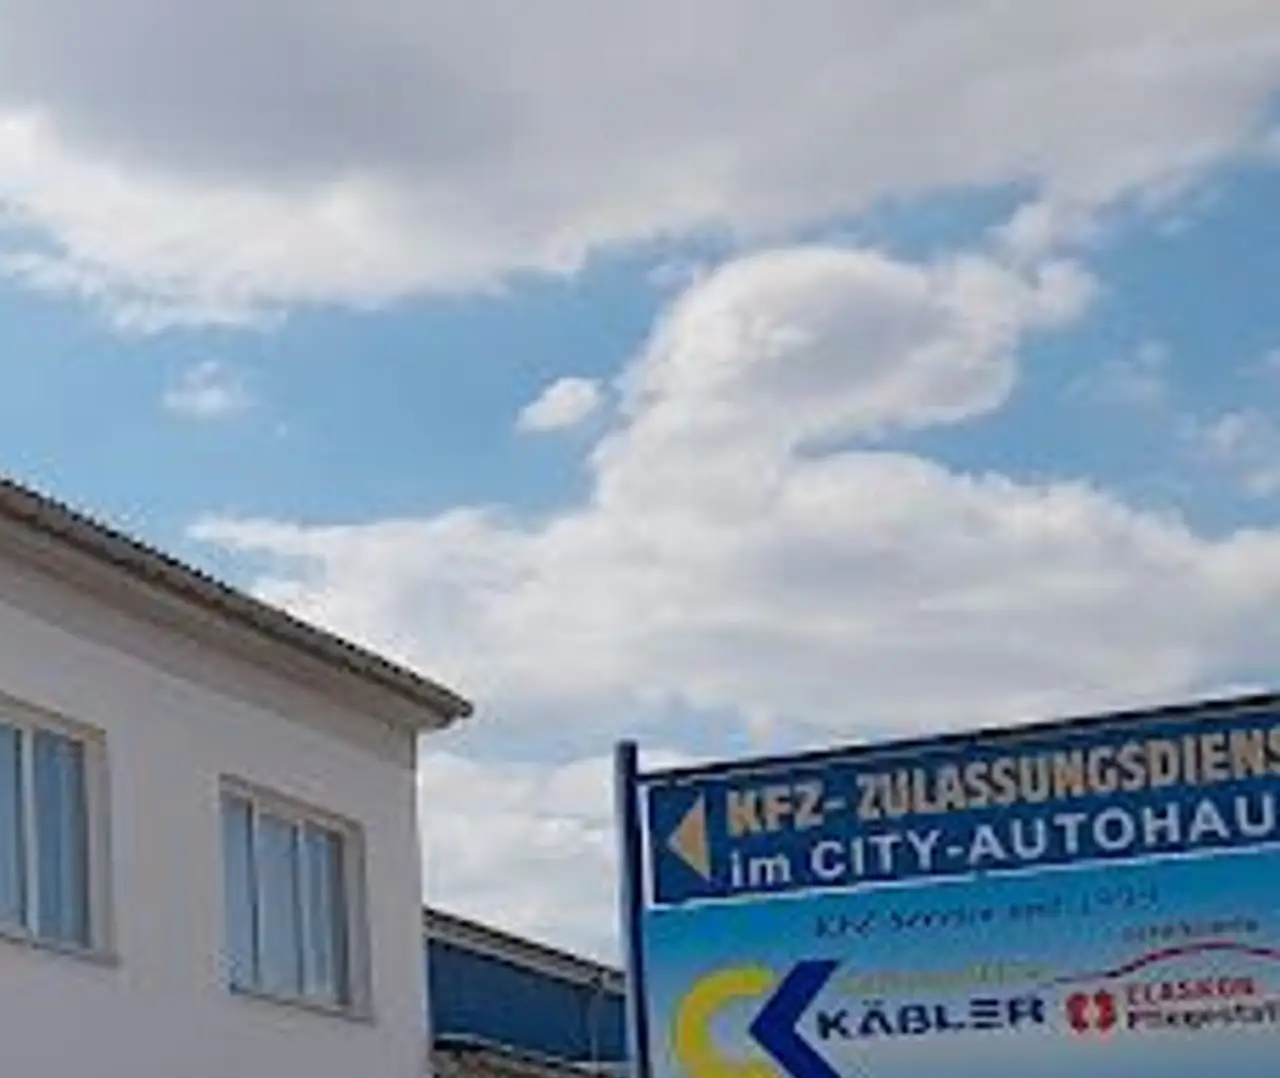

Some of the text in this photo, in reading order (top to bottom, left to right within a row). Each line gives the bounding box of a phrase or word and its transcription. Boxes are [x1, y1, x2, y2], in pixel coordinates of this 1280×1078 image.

[726, 785, 845, 836] KFZ-
[730, 792, 1276, 888] im CITY-AUTOHAU
